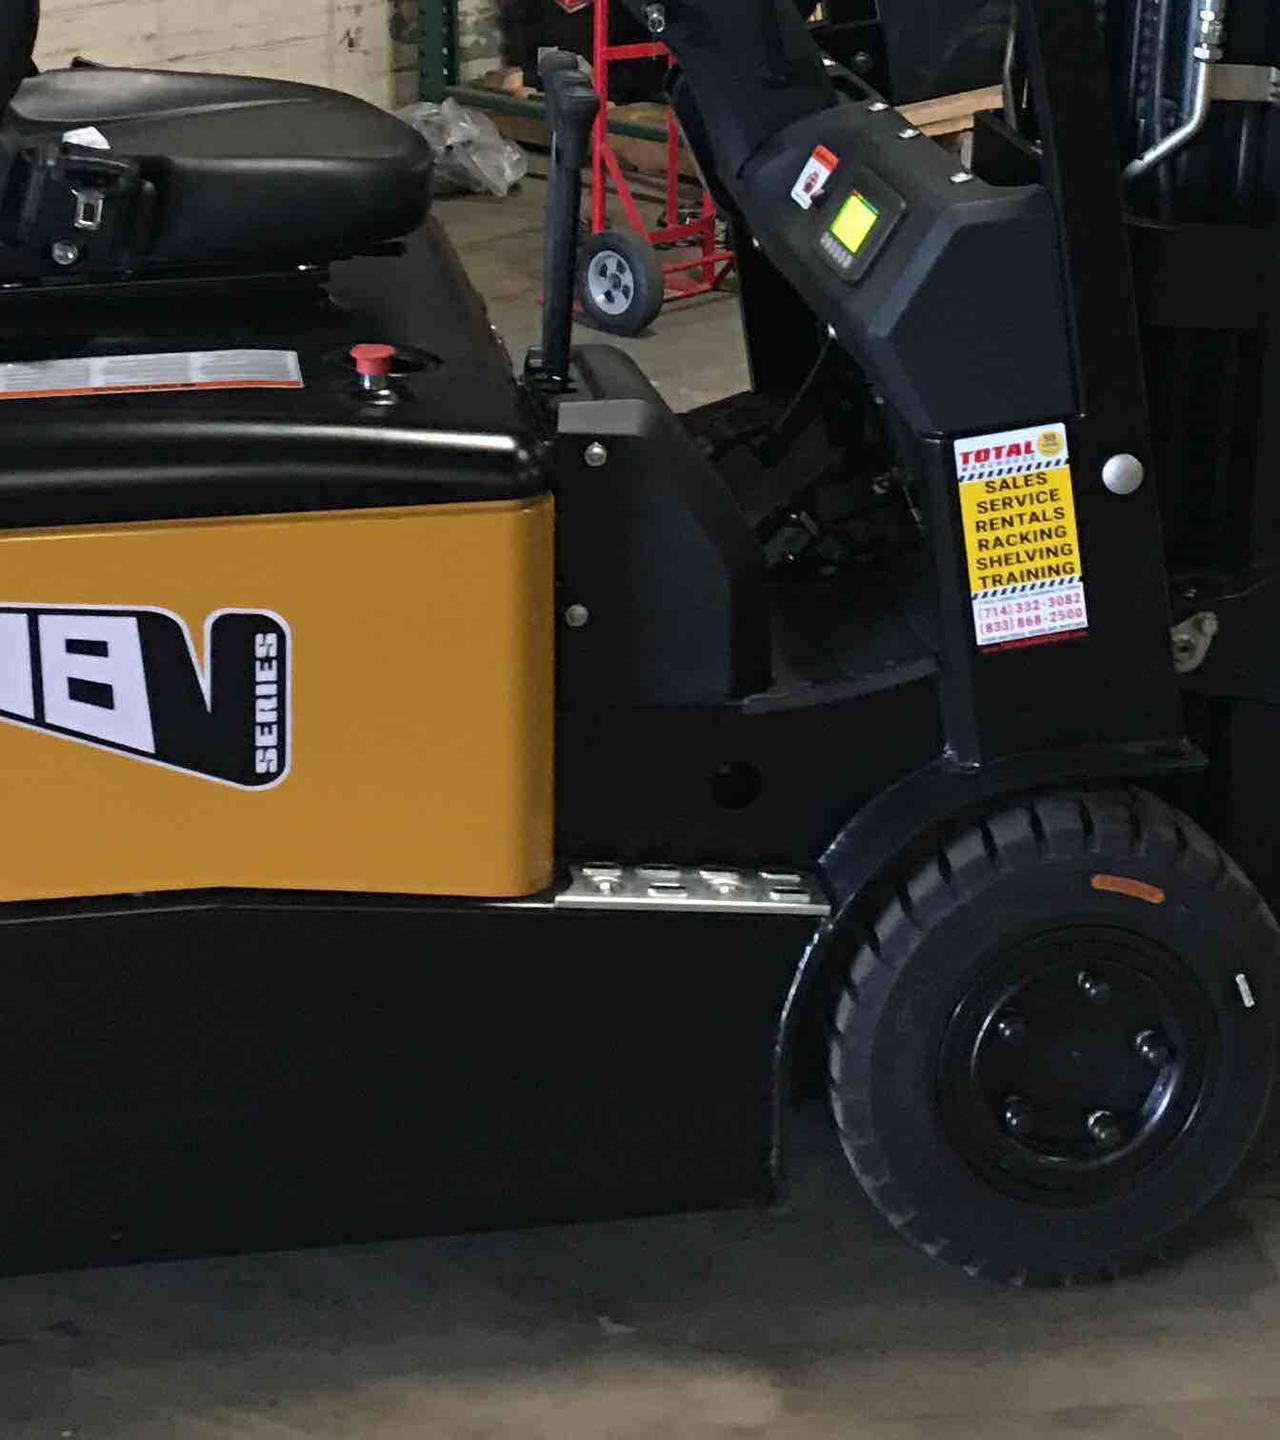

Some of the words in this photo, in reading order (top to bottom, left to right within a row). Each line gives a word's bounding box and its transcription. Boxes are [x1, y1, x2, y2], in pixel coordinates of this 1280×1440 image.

[959, 441, 1035, 465] TOTAL
[985, 471, 1048, 494] SALES
[977, 488, 1061, 515] SERVICE
[975, 507, 1065, 534] RENTALS
[978, 525, 1068, 552] RACKING
[976, 543, 1073, 571] SHELVING
[978, 561, 1076, 590] TRAINING
[254, 632, 278, 775] SERIES
